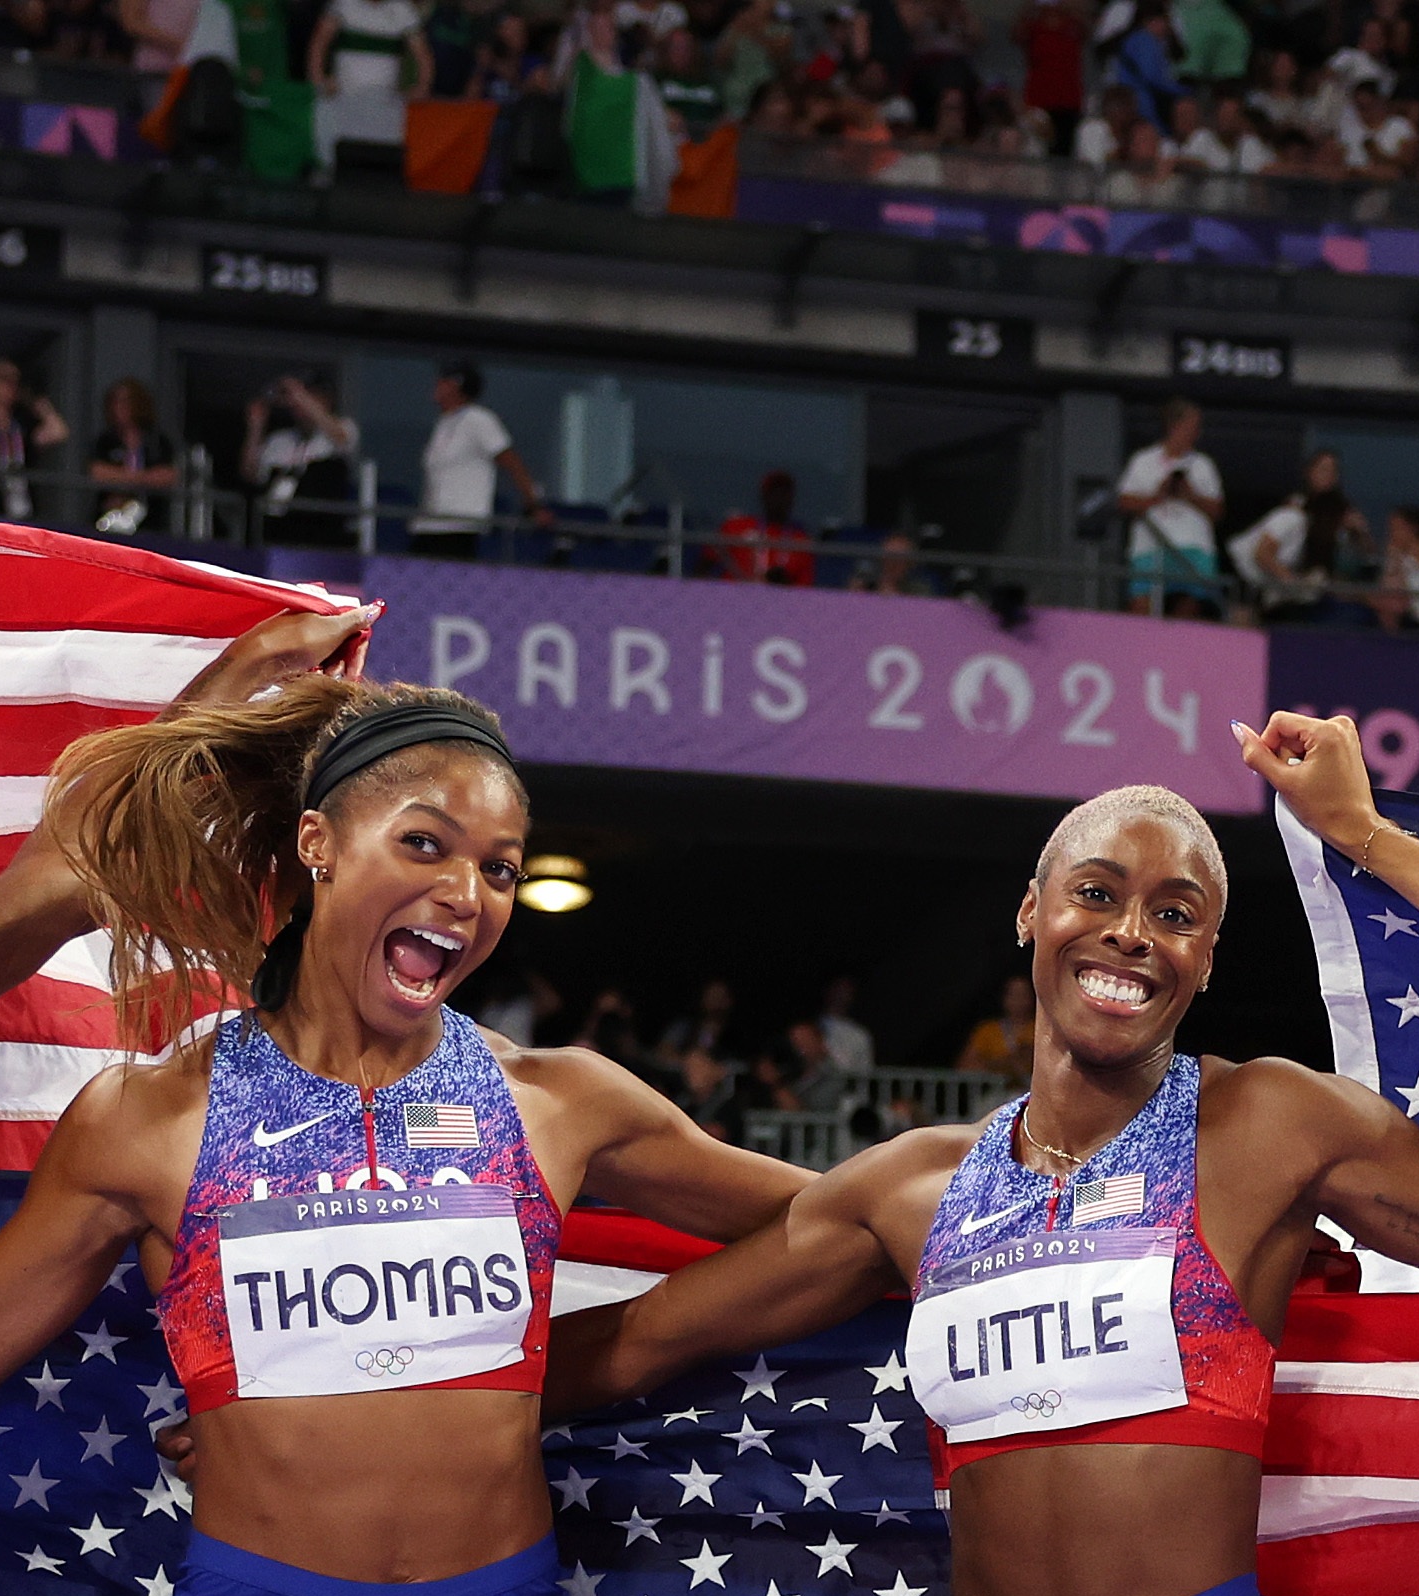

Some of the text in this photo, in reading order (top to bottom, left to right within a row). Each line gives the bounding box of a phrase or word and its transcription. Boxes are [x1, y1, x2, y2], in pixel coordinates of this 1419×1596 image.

[948, 320, 1002, 357] 25
[867, 644, 1201, 754] 2024
[376, 1194, 441, 1214] 2024
[1032, 1239, 1096, 1259] 2024
[234, 1252, 524, 1332] THOMAS
[947, 1292, 1129, 1382] LITTLE
